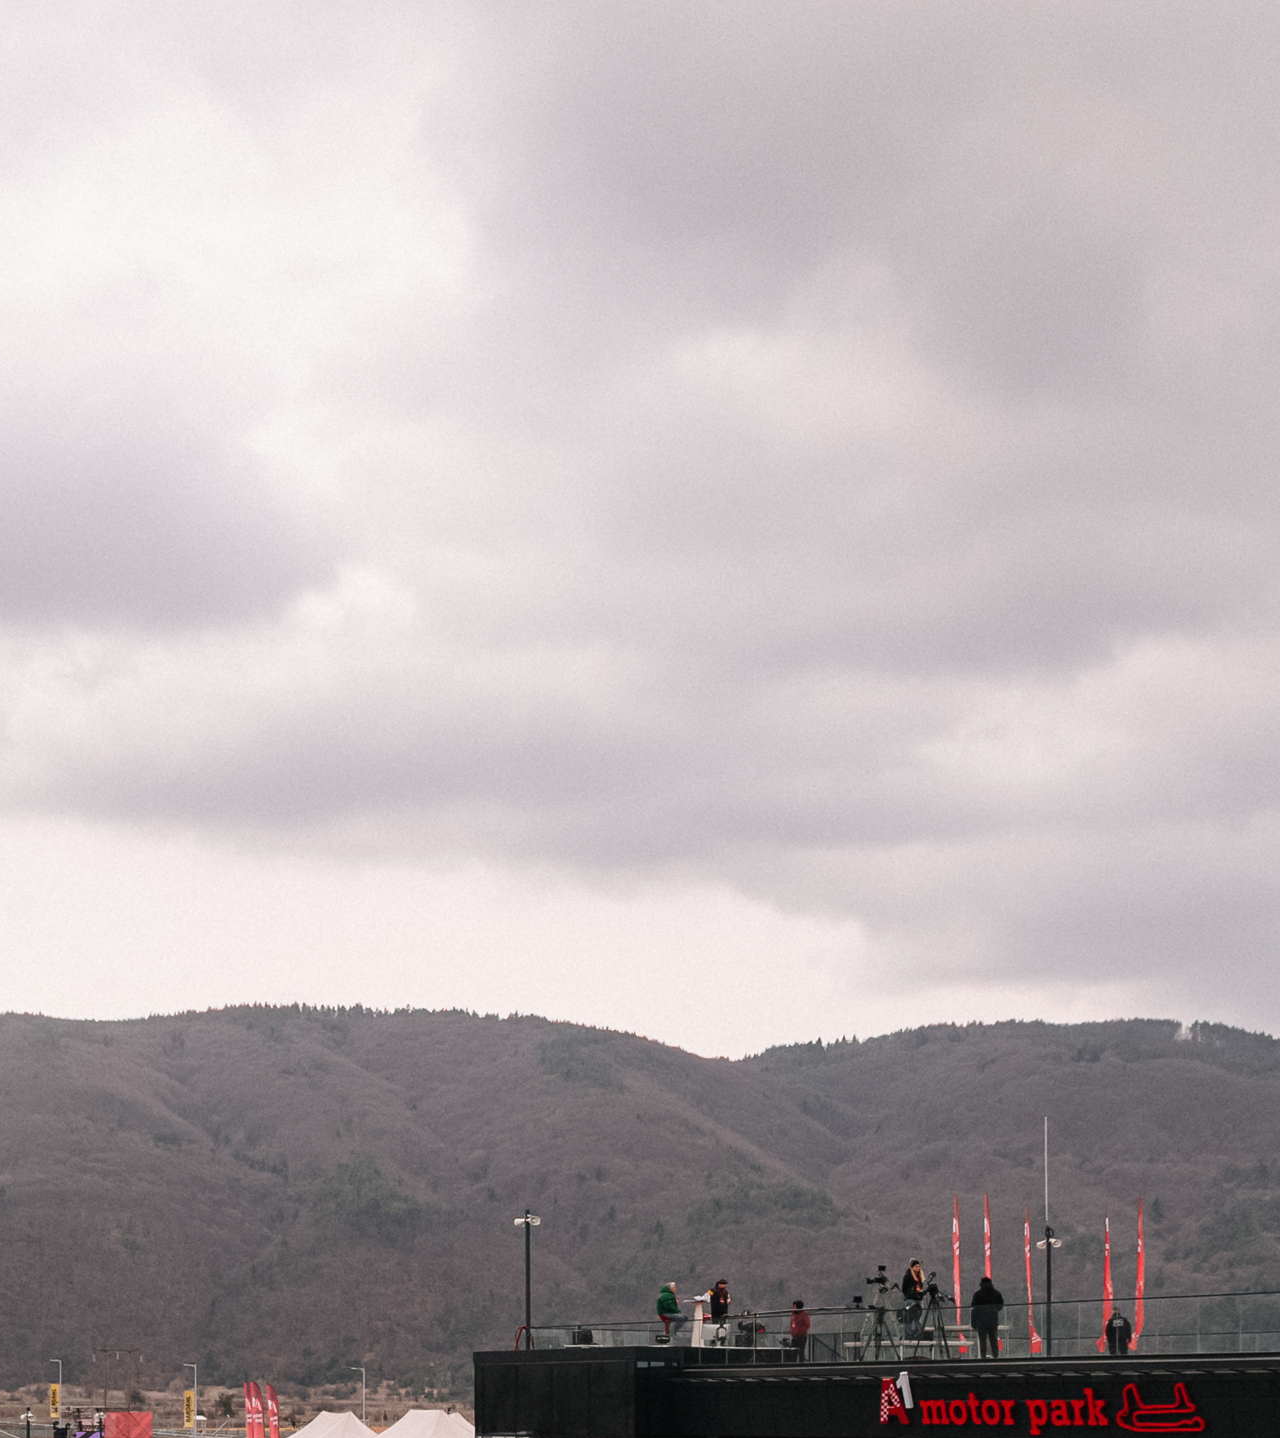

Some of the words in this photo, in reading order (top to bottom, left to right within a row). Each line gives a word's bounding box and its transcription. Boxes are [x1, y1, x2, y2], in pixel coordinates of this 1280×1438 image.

[880, 1371, 914, 1425] A1
[919, 1392, 1016, 1427] motor
[1026, 1387, 1110, 1436] park
